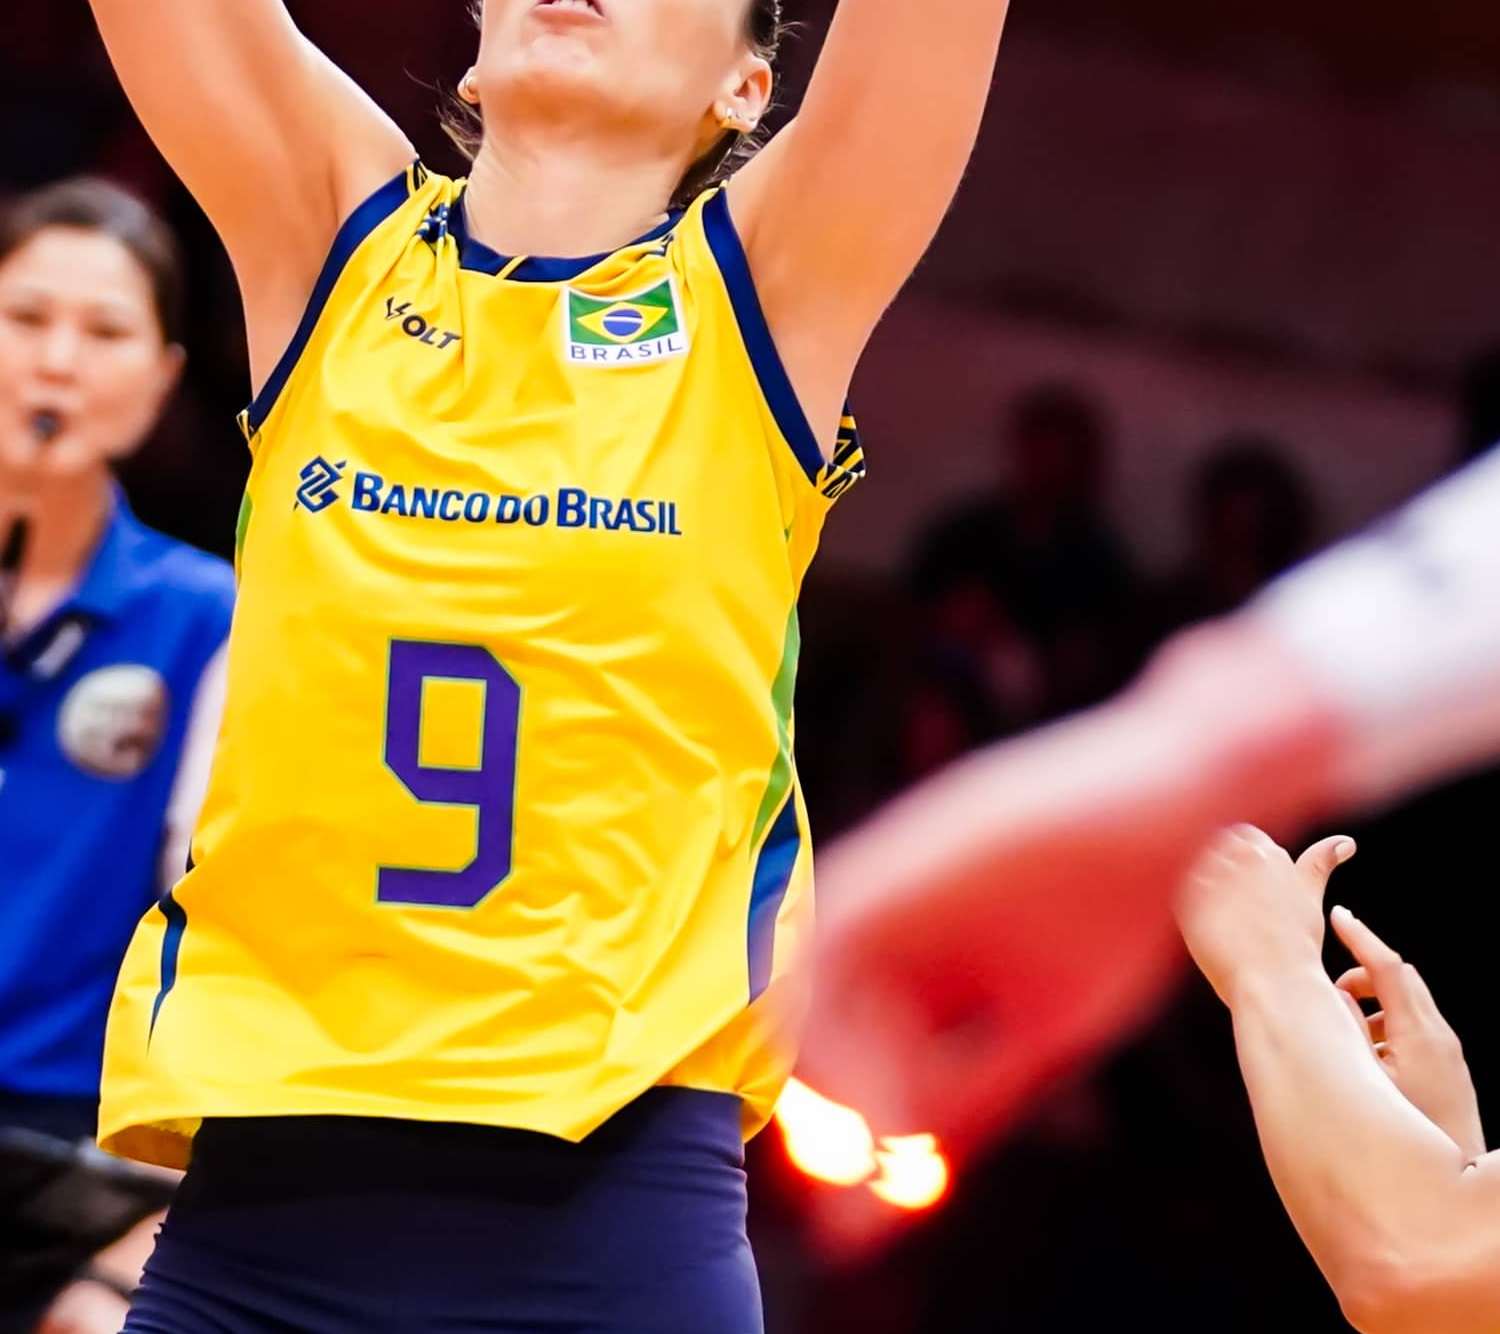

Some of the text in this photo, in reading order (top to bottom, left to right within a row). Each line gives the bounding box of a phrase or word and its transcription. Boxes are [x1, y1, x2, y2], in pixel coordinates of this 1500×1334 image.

[385, 295, 461, 351] VOLT
[570, 337, 685, 362] BRASIL
[351, 472, 683, 536] BANCO DO BRASIL
[373, 635, 525, 910] 9
